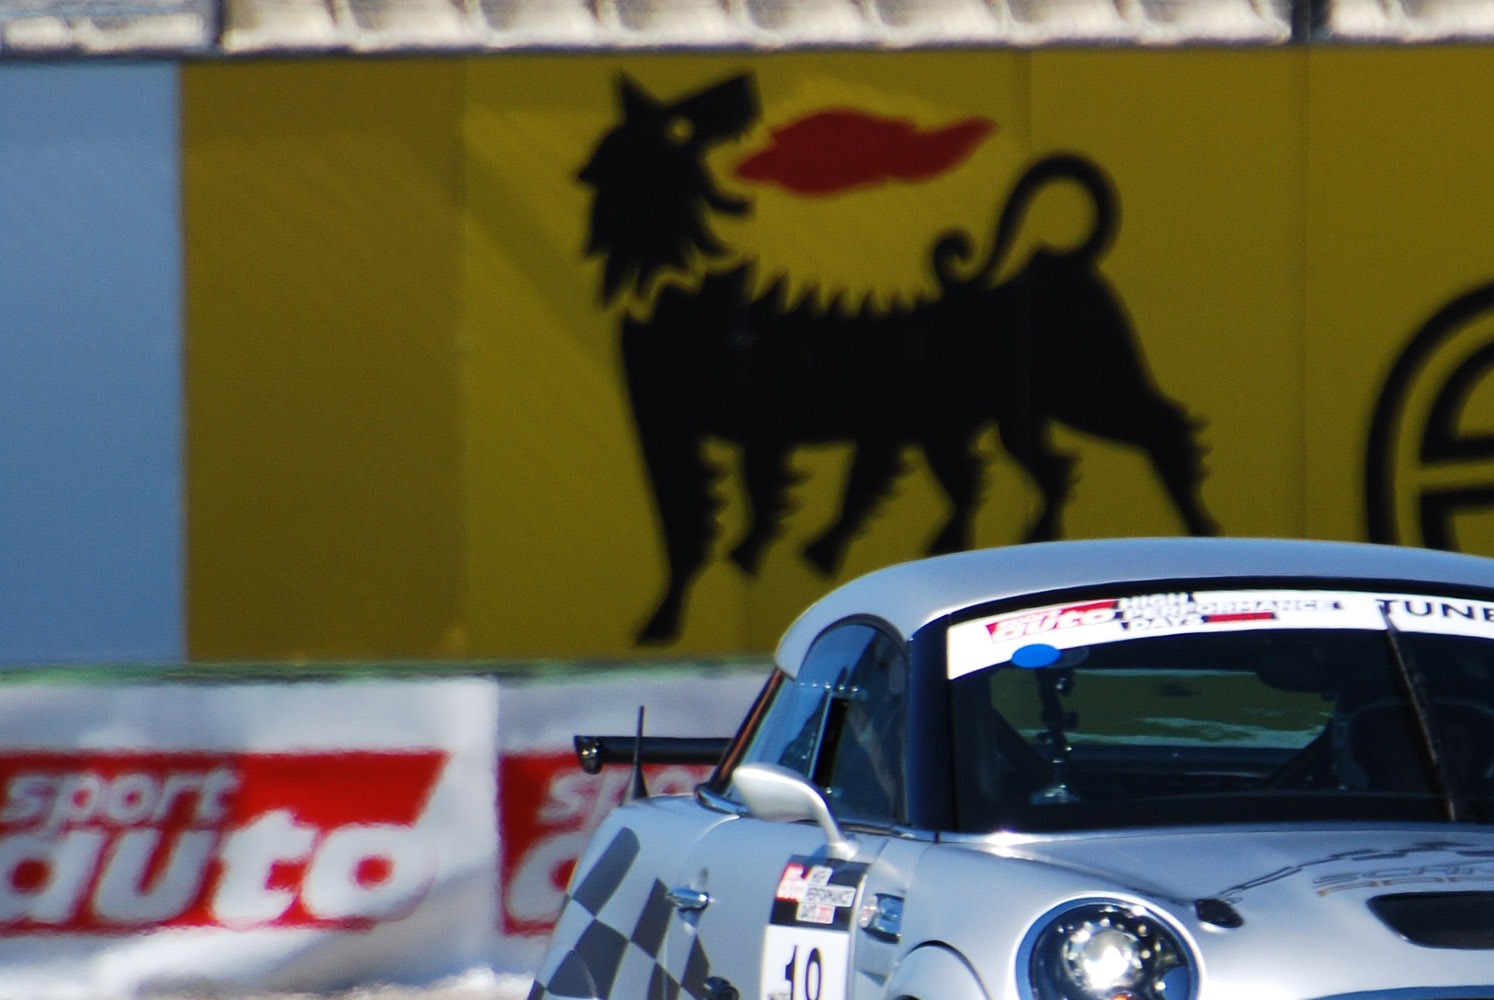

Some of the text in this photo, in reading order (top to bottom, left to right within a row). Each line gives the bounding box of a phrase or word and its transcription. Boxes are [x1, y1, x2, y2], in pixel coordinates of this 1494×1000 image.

[1119, 592, 1188, 610] HIGH
[1119, 599, 1336, 620] PERFORMANCE
[1127, 614, 1203, 632] DAYS
[2, 767, 241, 838] sport
[0, 809, 434, 925] auto
